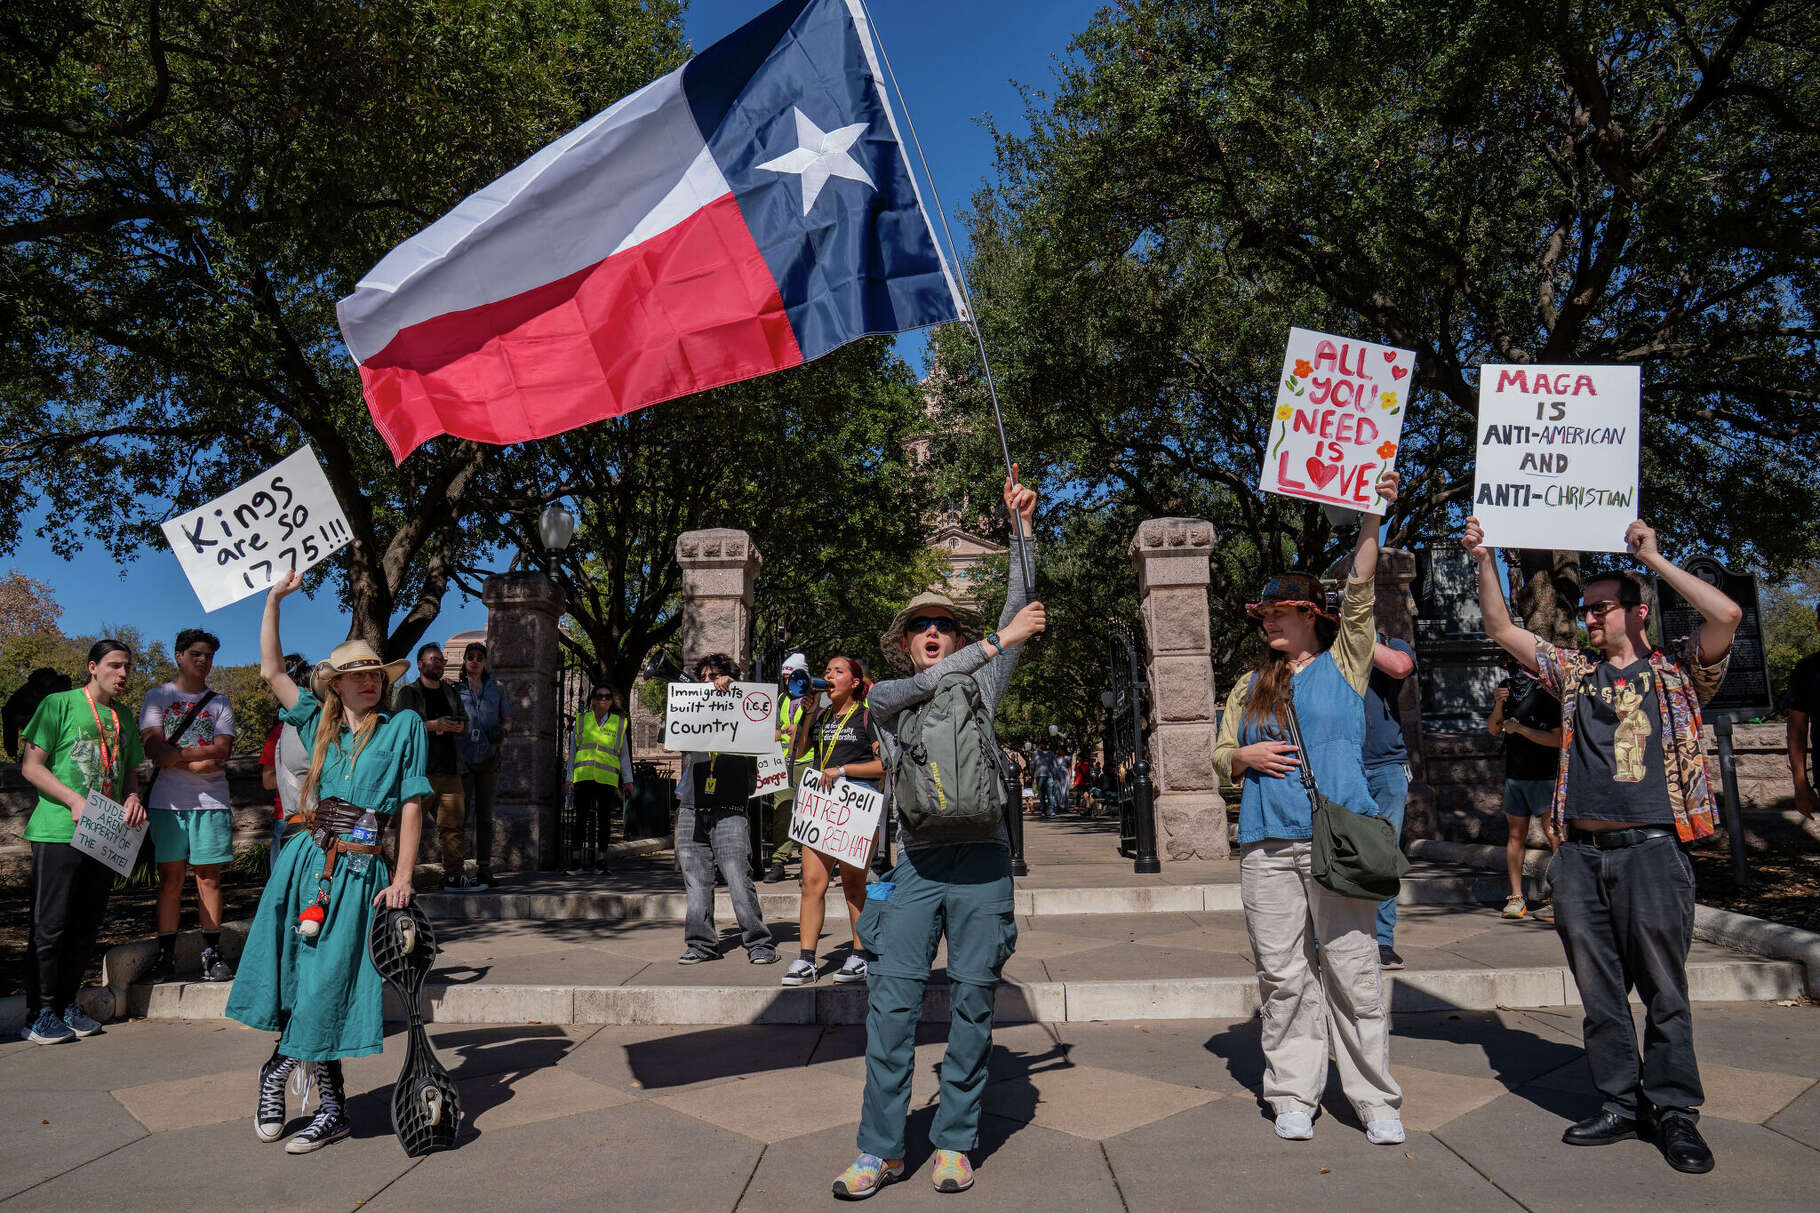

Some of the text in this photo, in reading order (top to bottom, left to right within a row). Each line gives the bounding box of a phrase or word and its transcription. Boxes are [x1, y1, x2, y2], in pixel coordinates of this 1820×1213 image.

[1313, 340, 1373, 380] ALL
[1309, 377, 1378, 413] YOU
[1496, 370, 1597, 396] MAGA
[1293, 409, 1378, 445] NEED
[1536, 402, 1566, 421] IS
[1315, 440, 1344, 462] IS
[1482, 425, 1626, 445] ANTI-AMERICAN
[1519, 452, 1569, 474] AND
[1476, 483, 1633, 510] ANTI-CHRISTIAN
[181, 476, 293, 553] Kings
[217, 533, 268, 566] are
[243, 518, 349, 589] 1775!!!
[670, 701, 734, 713] built this
[839, 784, 875, 813] Spell
[929, 762, 948, 810] patagonia
[90, 794, 143, 833] STUDES
[79, 816, 132, 851] PROPERTY OF
[79, 833, 97, 849] THE
[821, 826, 849, 852] RED
[848, 834, 872, 863] HAT
